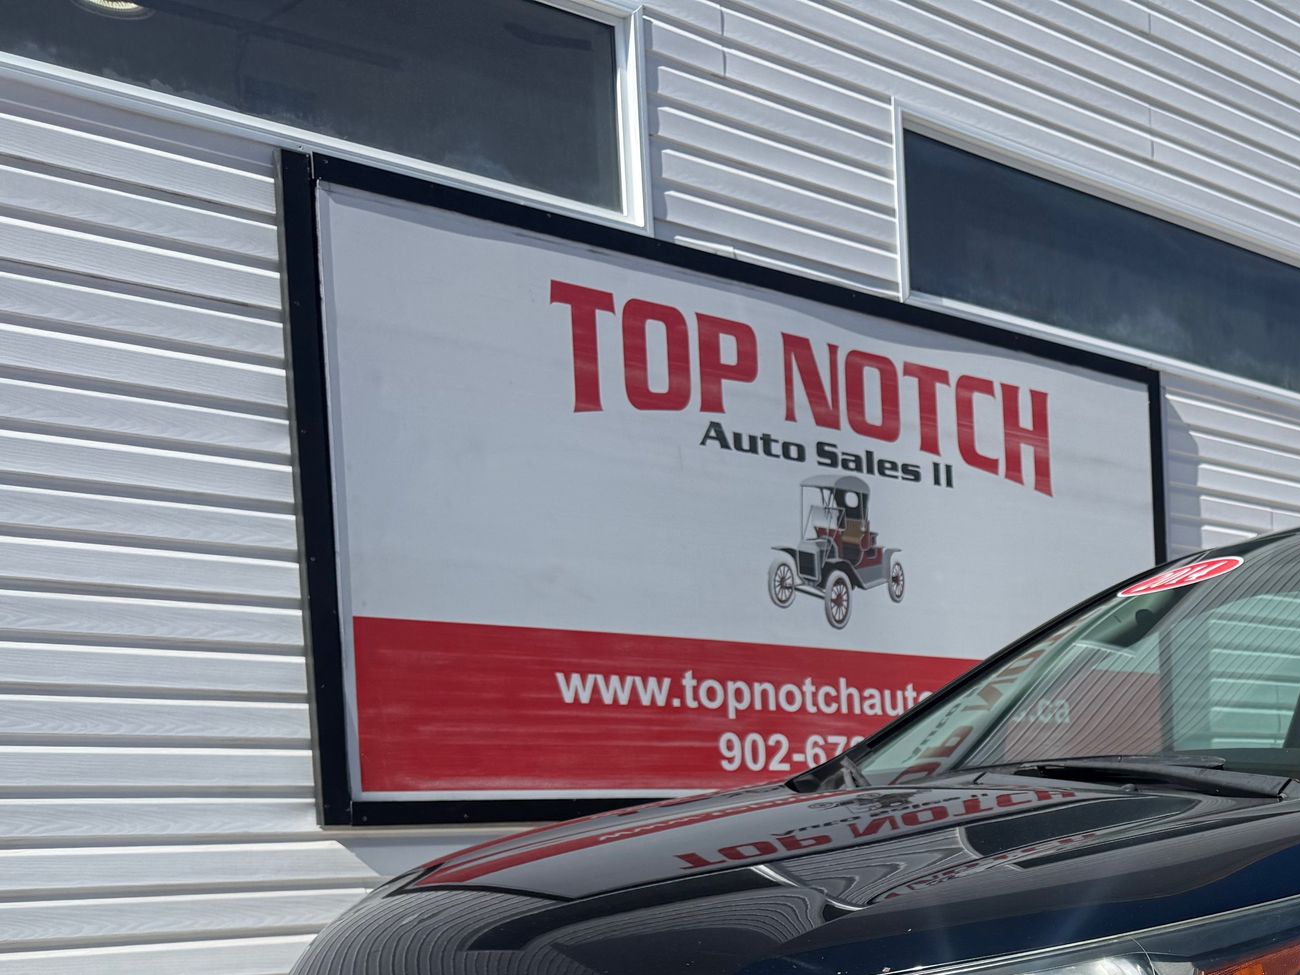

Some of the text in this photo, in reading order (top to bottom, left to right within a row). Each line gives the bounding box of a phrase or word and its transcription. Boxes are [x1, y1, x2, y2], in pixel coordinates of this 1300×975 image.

[550, 279, 1053, 497] TOP NOTCH
[700, 420, 953, 488] Auto Sales II
[555, 670, 932, 718] www.topnotchaut
[719, 732, 865, 771] 902-67
